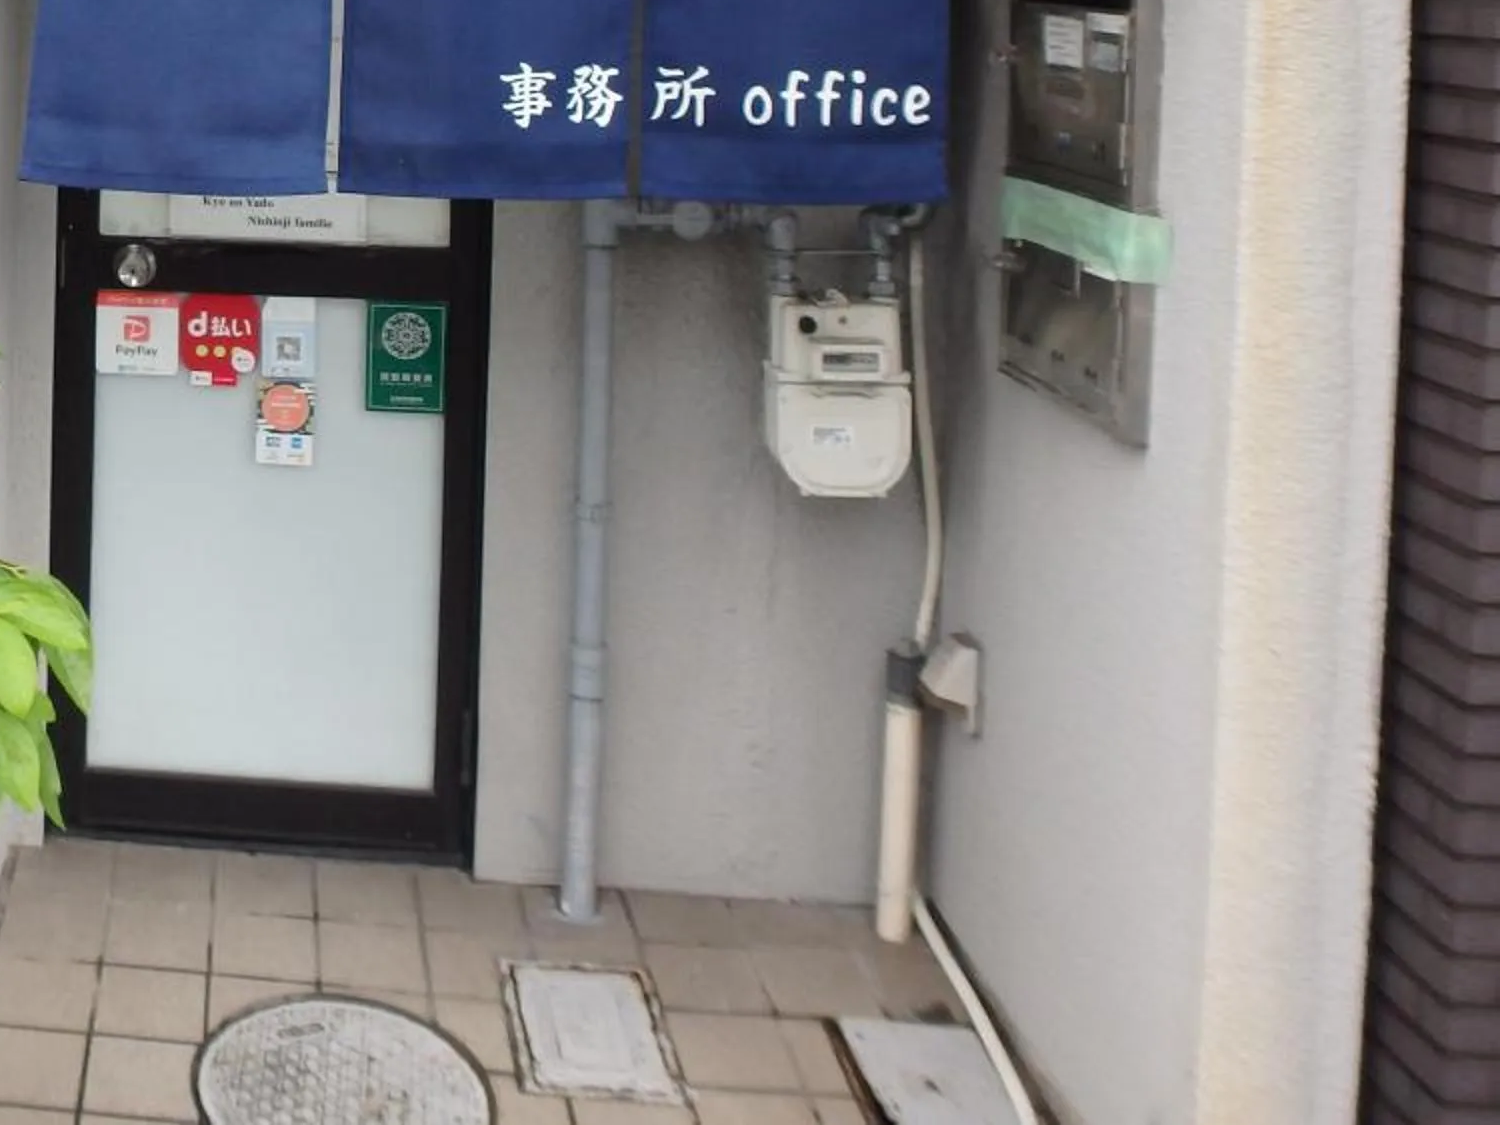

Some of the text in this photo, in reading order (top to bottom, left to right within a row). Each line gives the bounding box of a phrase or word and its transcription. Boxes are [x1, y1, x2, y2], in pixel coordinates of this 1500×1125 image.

[743, 70, 932, 127] office
[188, 311, 251, 337] d払い
[115, 344, 159, 357] PayPay
